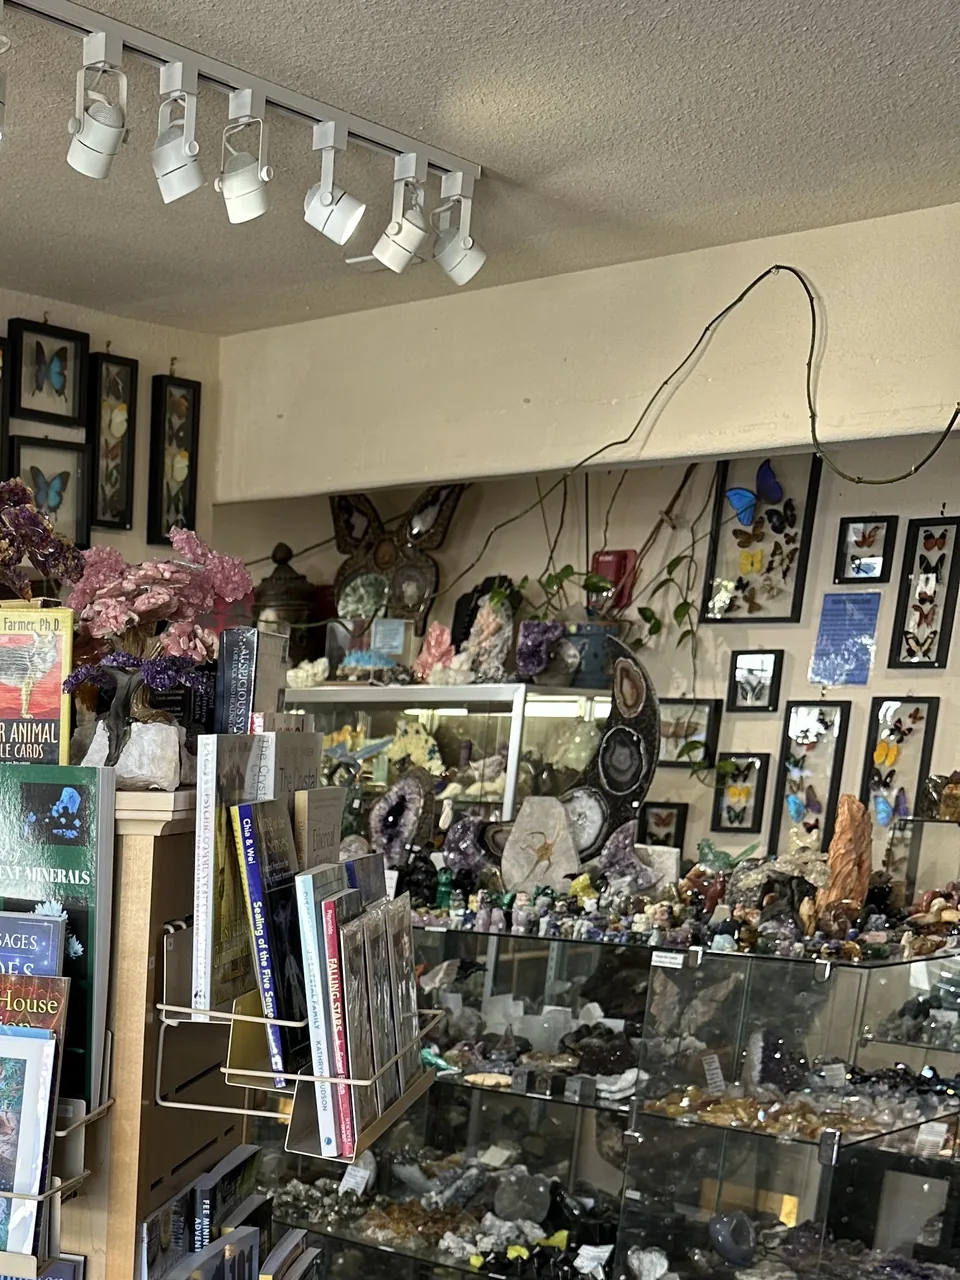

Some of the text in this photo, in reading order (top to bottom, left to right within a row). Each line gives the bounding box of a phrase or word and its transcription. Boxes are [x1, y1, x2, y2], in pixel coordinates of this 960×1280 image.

[3, 617, 36, 633] Farmer,
[39, 617, 61, 632] Ph.D.
[9, 722, 58, 743] ANIMAL
[14, 743, 44, 759] CARDS
[260, 737, 272, 761] The
[243, 818, 256, 864] Chia & Wei
[24, 867, 91, 885] MINERALS
[252, 901, 275, 1019] Sealing of the Five Sense
[327, 957, 341, 999] FALLING
[333, 1000, 343, 1032] STARS
[203, 1199, 211, 1215] FEE
